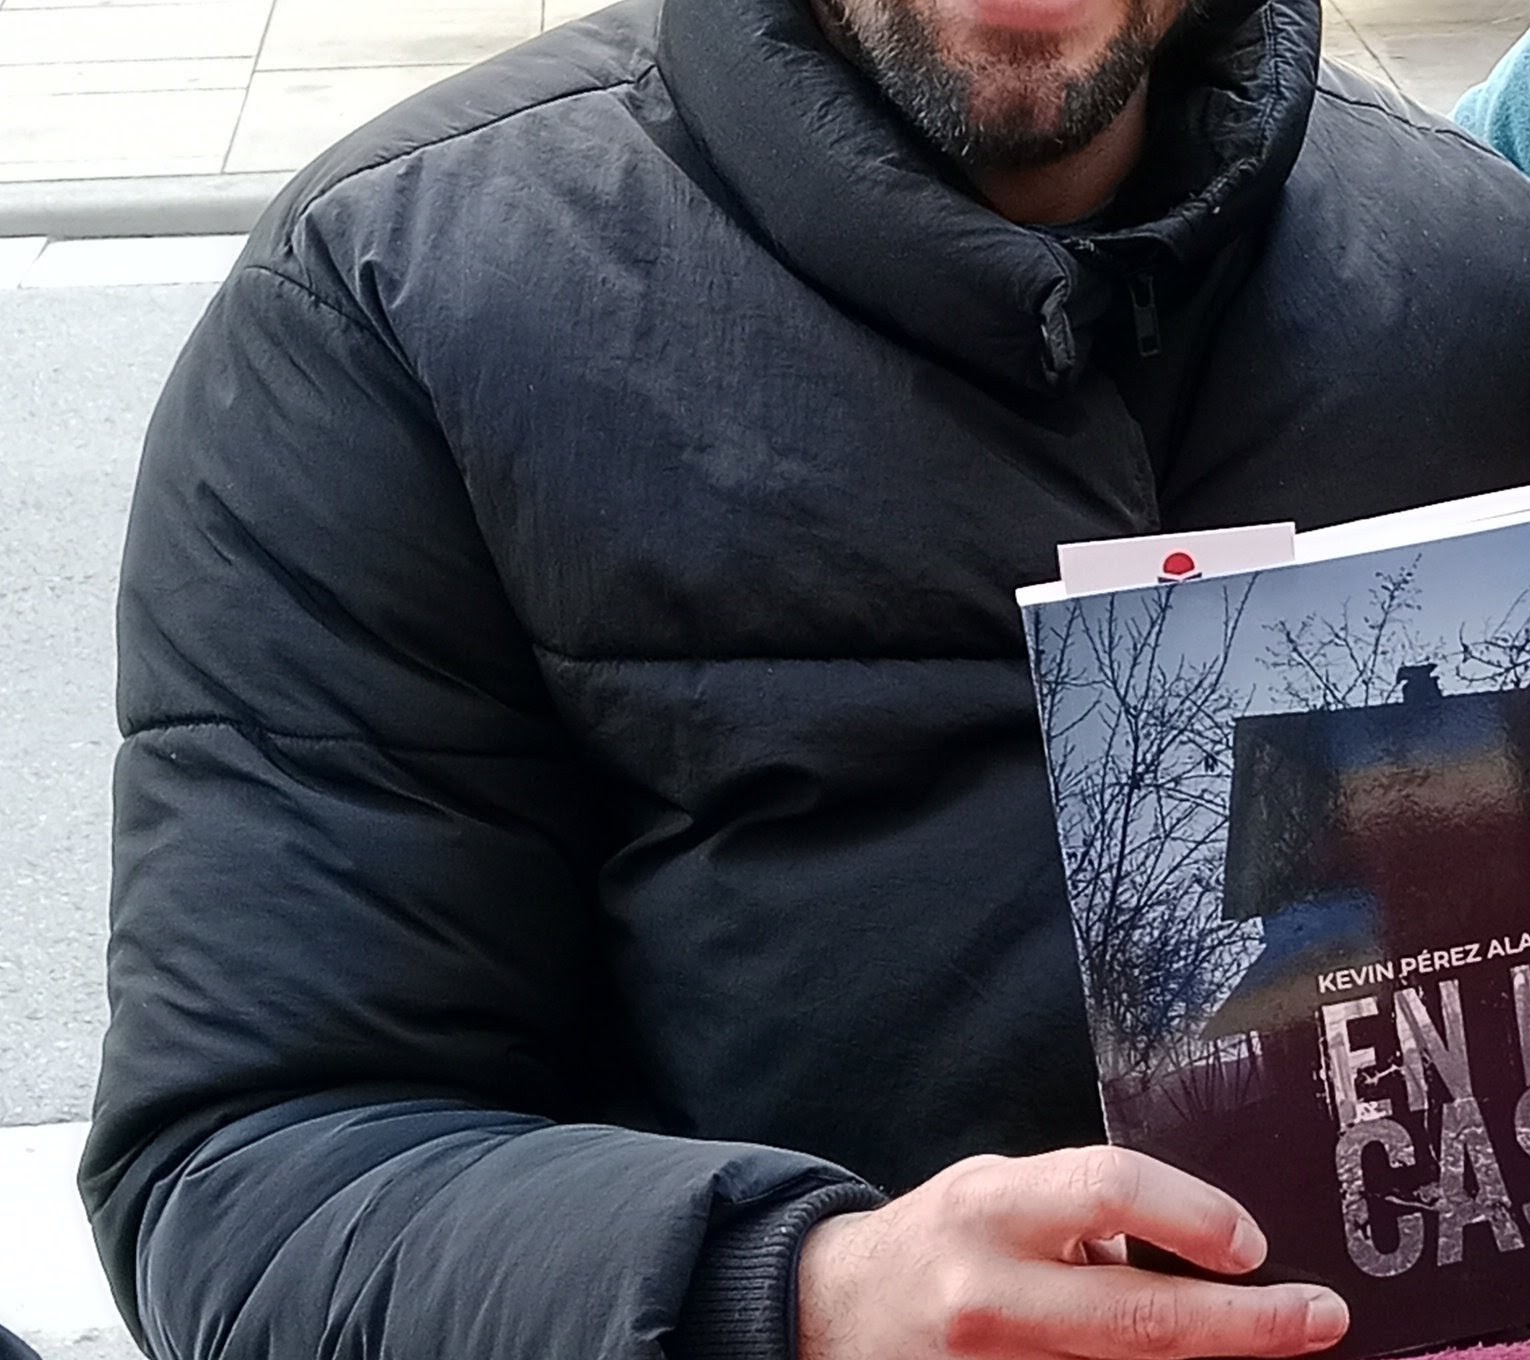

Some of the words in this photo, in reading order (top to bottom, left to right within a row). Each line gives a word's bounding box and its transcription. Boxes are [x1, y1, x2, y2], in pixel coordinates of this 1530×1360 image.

[1317, 960, 1394, 994] KEVIN
[1399, 941, 1482, 979] PÉREZ
[1318, 978, 1473, 1130] EN
